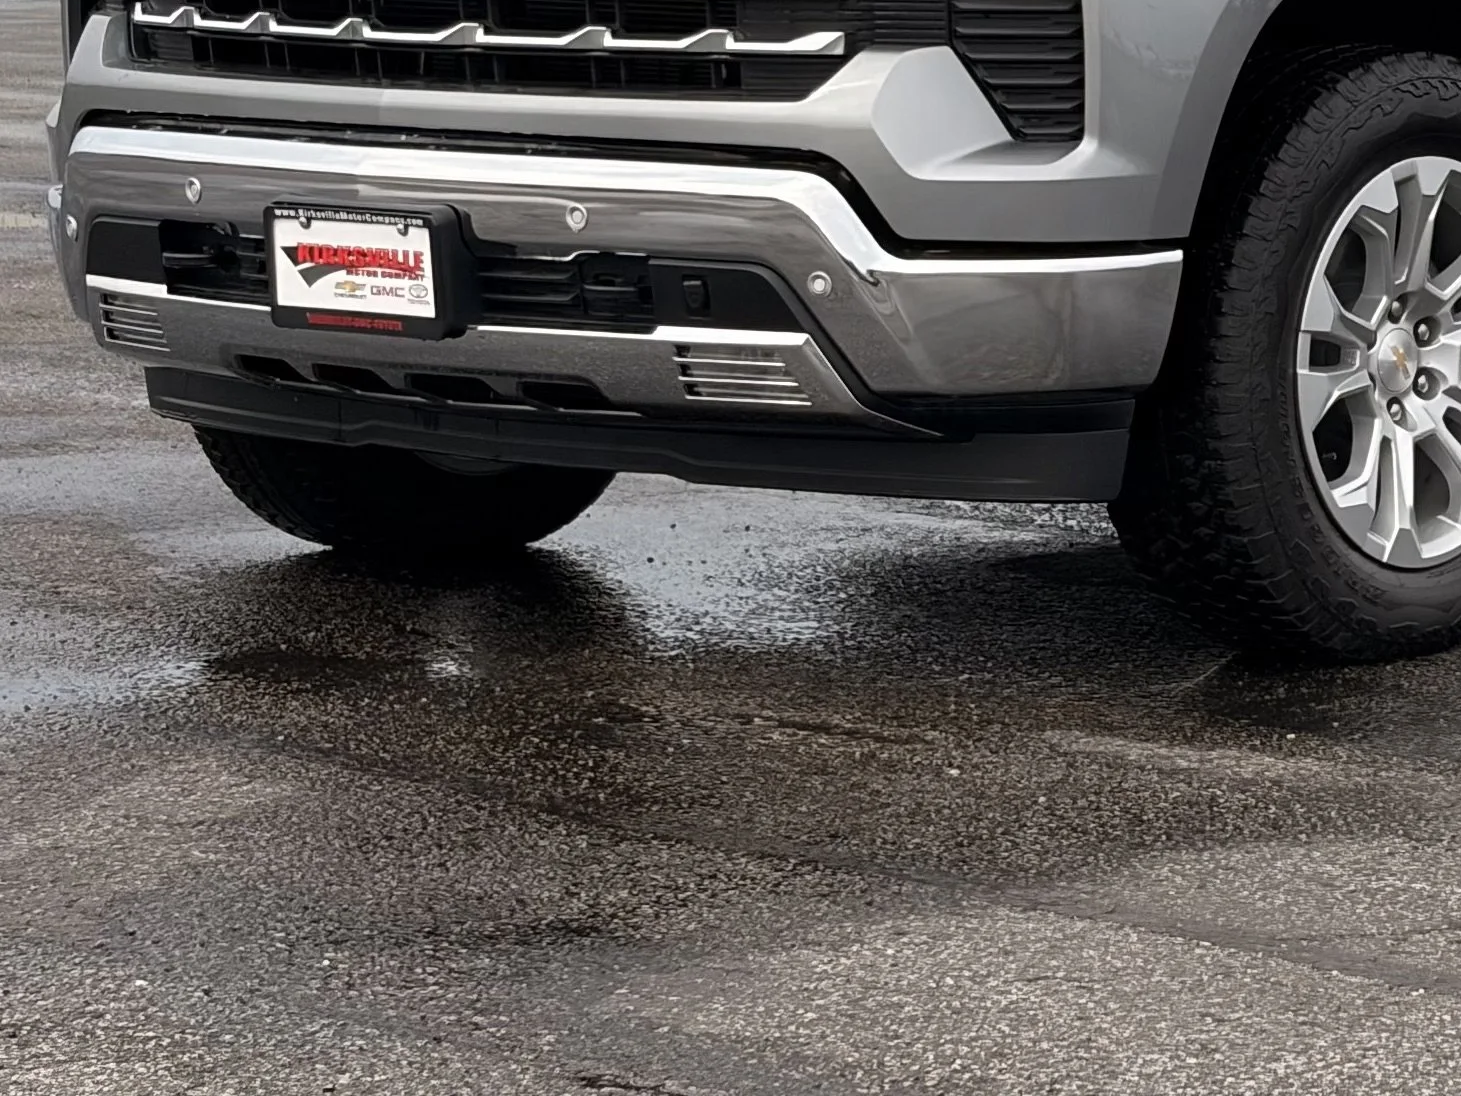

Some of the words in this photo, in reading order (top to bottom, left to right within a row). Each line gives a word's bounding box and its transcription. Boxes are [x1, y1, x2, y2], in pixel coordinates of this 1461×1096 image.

[297, 242, 425, 271] KIRKSVILLE
[381, 270, 425, 282] COMPANY
[371, 286, 406, 298] GMC
